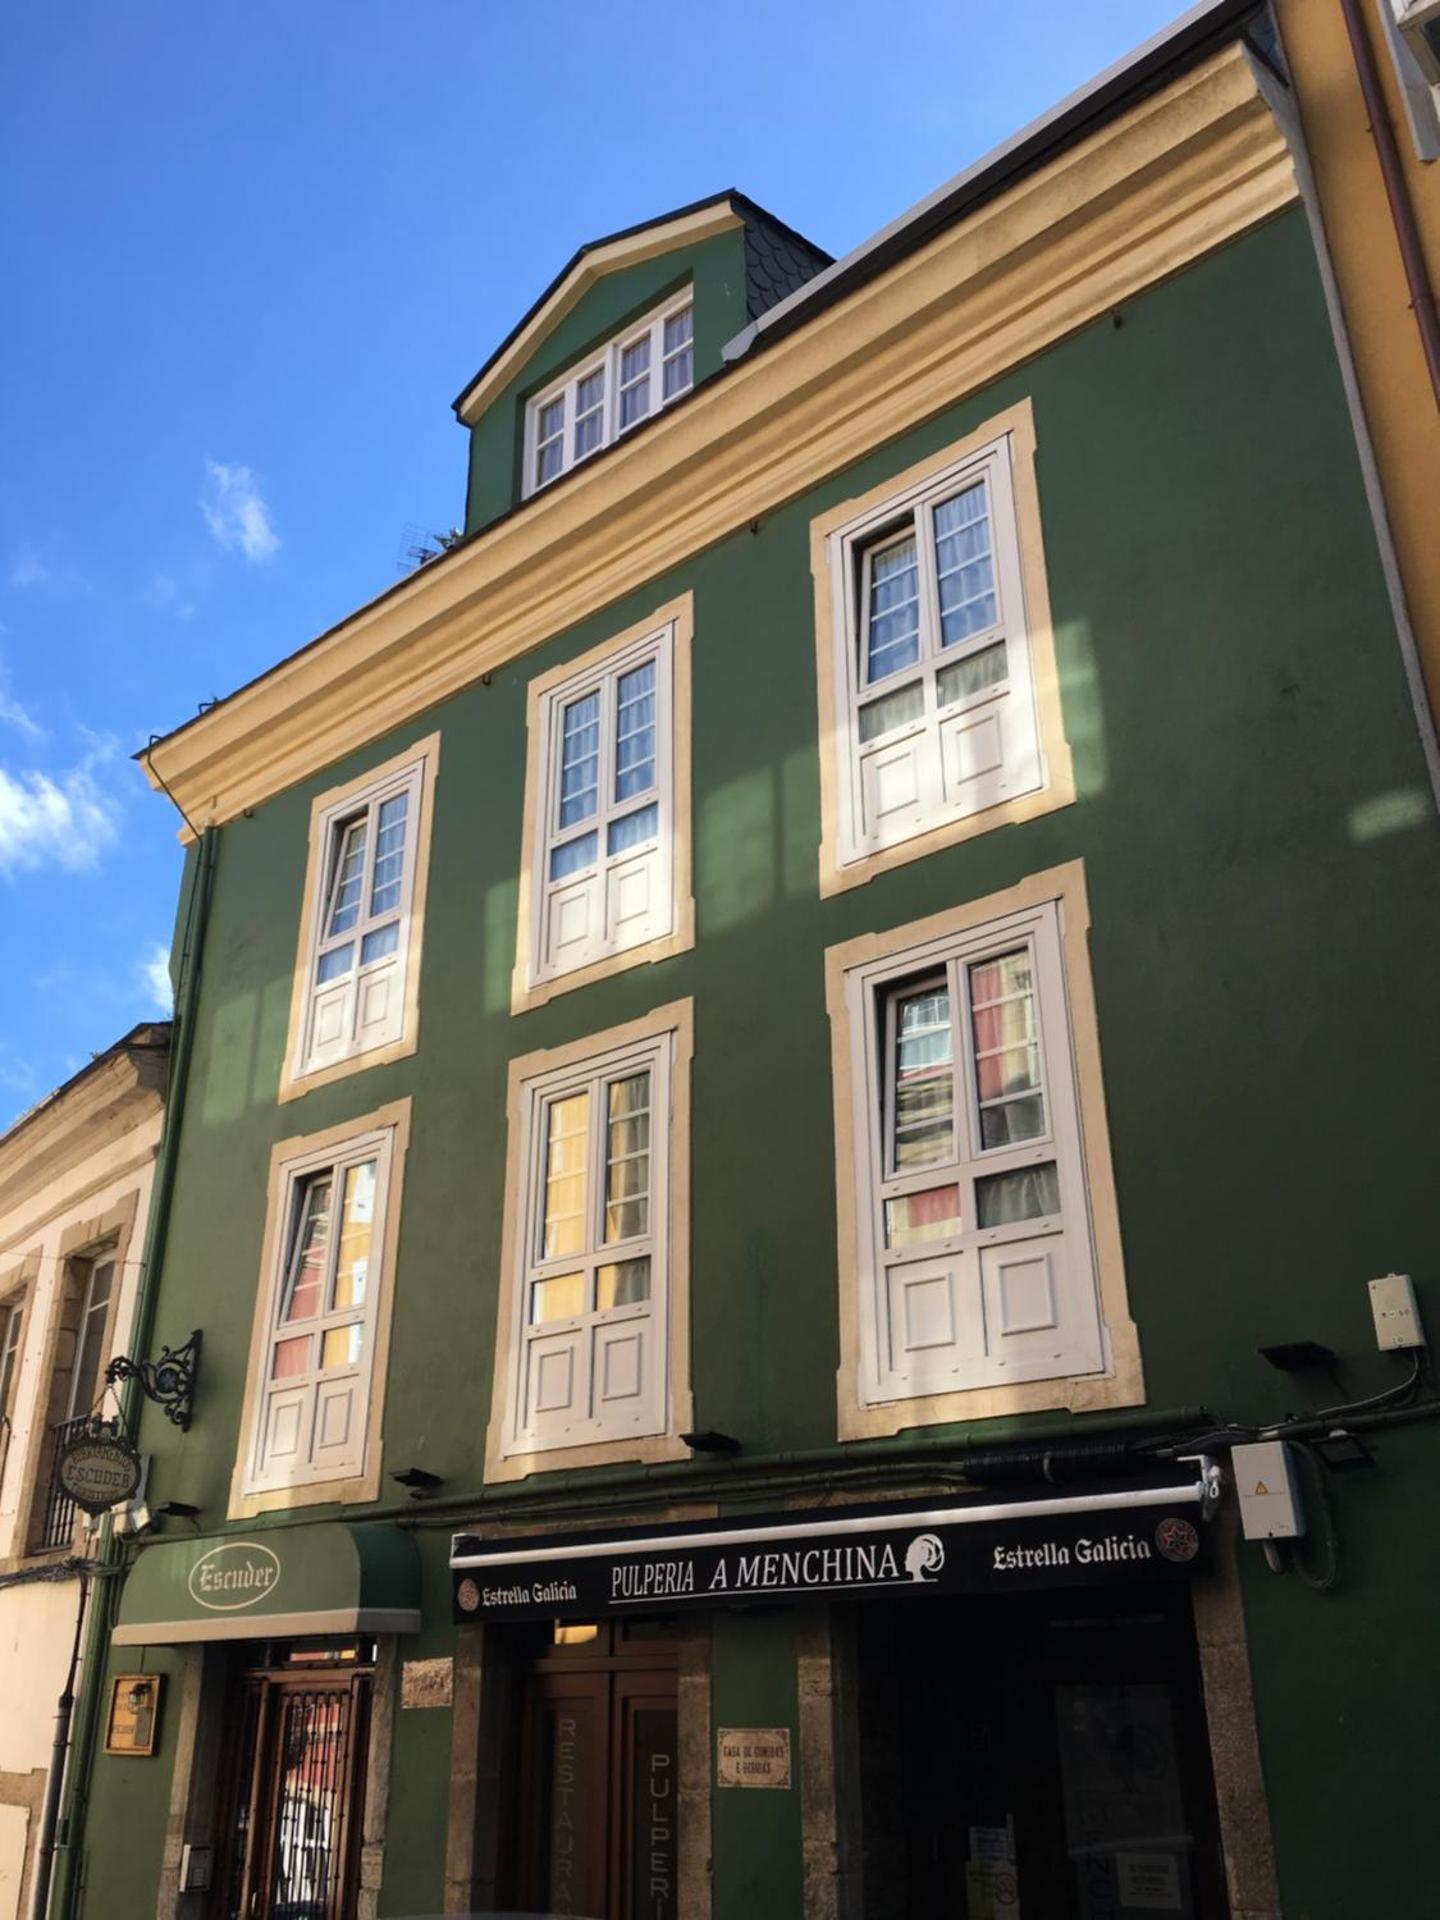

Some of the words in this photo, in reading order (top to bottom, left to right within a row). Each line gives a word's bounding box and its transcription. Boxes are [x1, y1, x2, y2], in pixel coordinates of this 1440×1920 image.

[992, 1543, 1070, 1570] Estrella
[1074, 1535, 1152, 1564] Galicia
[200, 1560, 274, 1592] Escuder
[611, 1560, 695, 1597] PULPERIA
[708, 1558, 728, 1589] A
[735, 1543, 900, 1588] MENCHINA
[481, 1586, 530, 1607] Estrella
[531, 1580, 577, 1604] Galicia
